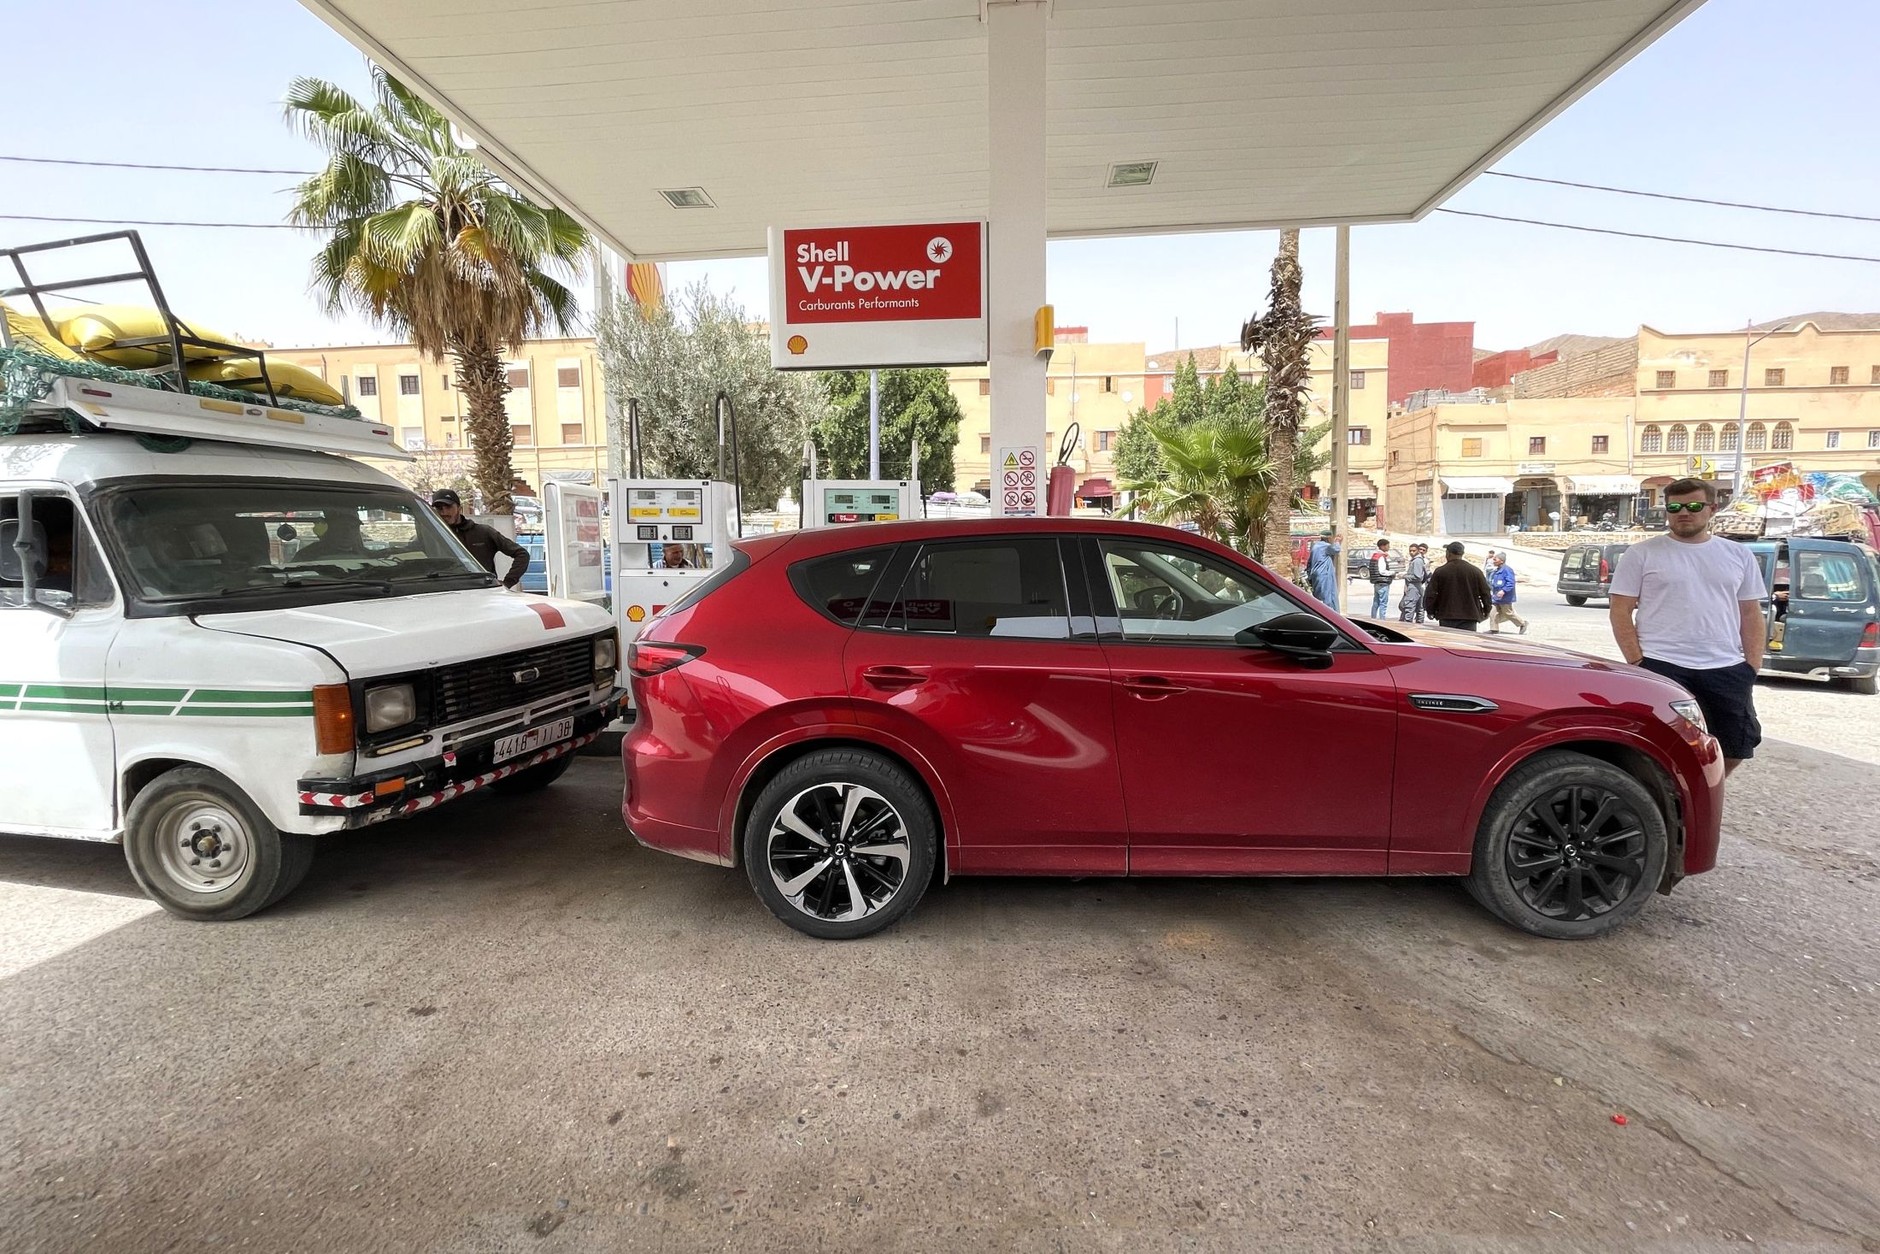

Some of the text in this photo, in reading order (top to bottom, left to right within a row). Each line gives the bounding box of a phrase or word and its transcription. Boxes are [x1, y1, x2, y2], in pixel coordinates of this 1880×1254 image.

[797, 241, 849, 263] Shell
[797, 265, 940, 293] V-Power
[799, 297, 919, 311] Carburants Performants
[499, 735, 528, 758] 4418
[557, 720, 570, 739] 38
